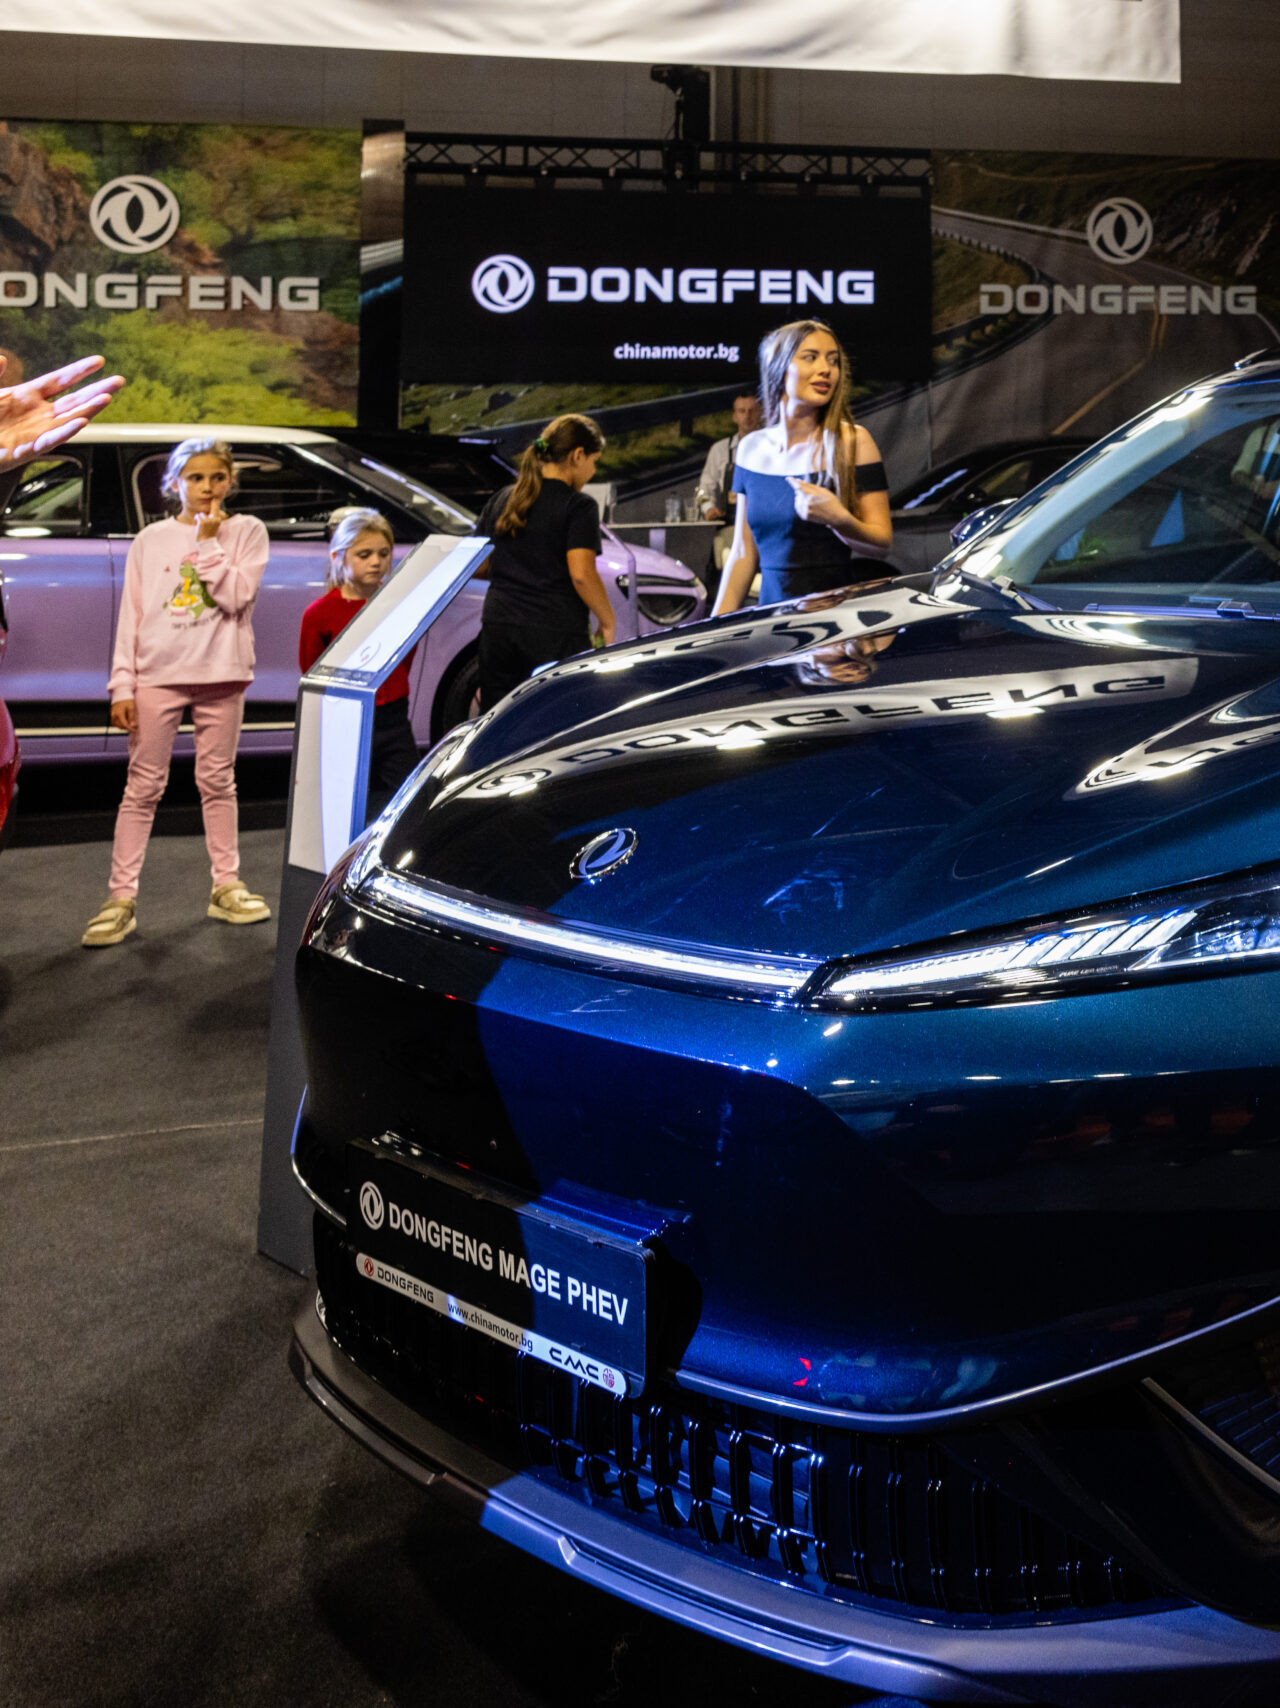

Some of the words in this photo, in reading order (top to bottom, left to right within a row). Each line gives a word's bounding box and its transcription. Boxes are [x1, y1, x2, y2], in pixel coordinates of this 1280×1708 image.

[547, 266, 875, 305] DONGFENG
[979, 284, 1257, 315] DONGFENG
[613, 343, 739, 363] chinamotor.bg
[388, 1202, 493, 1271] DONGFENG
[499, 1249, 562, 1301] MAGE
[567, 1276, 629, 1325] PHEV
[376, 1267, 434, 1303] DONGFENG
[447, 1301, 534, 1352] www.chinamotor.bg
